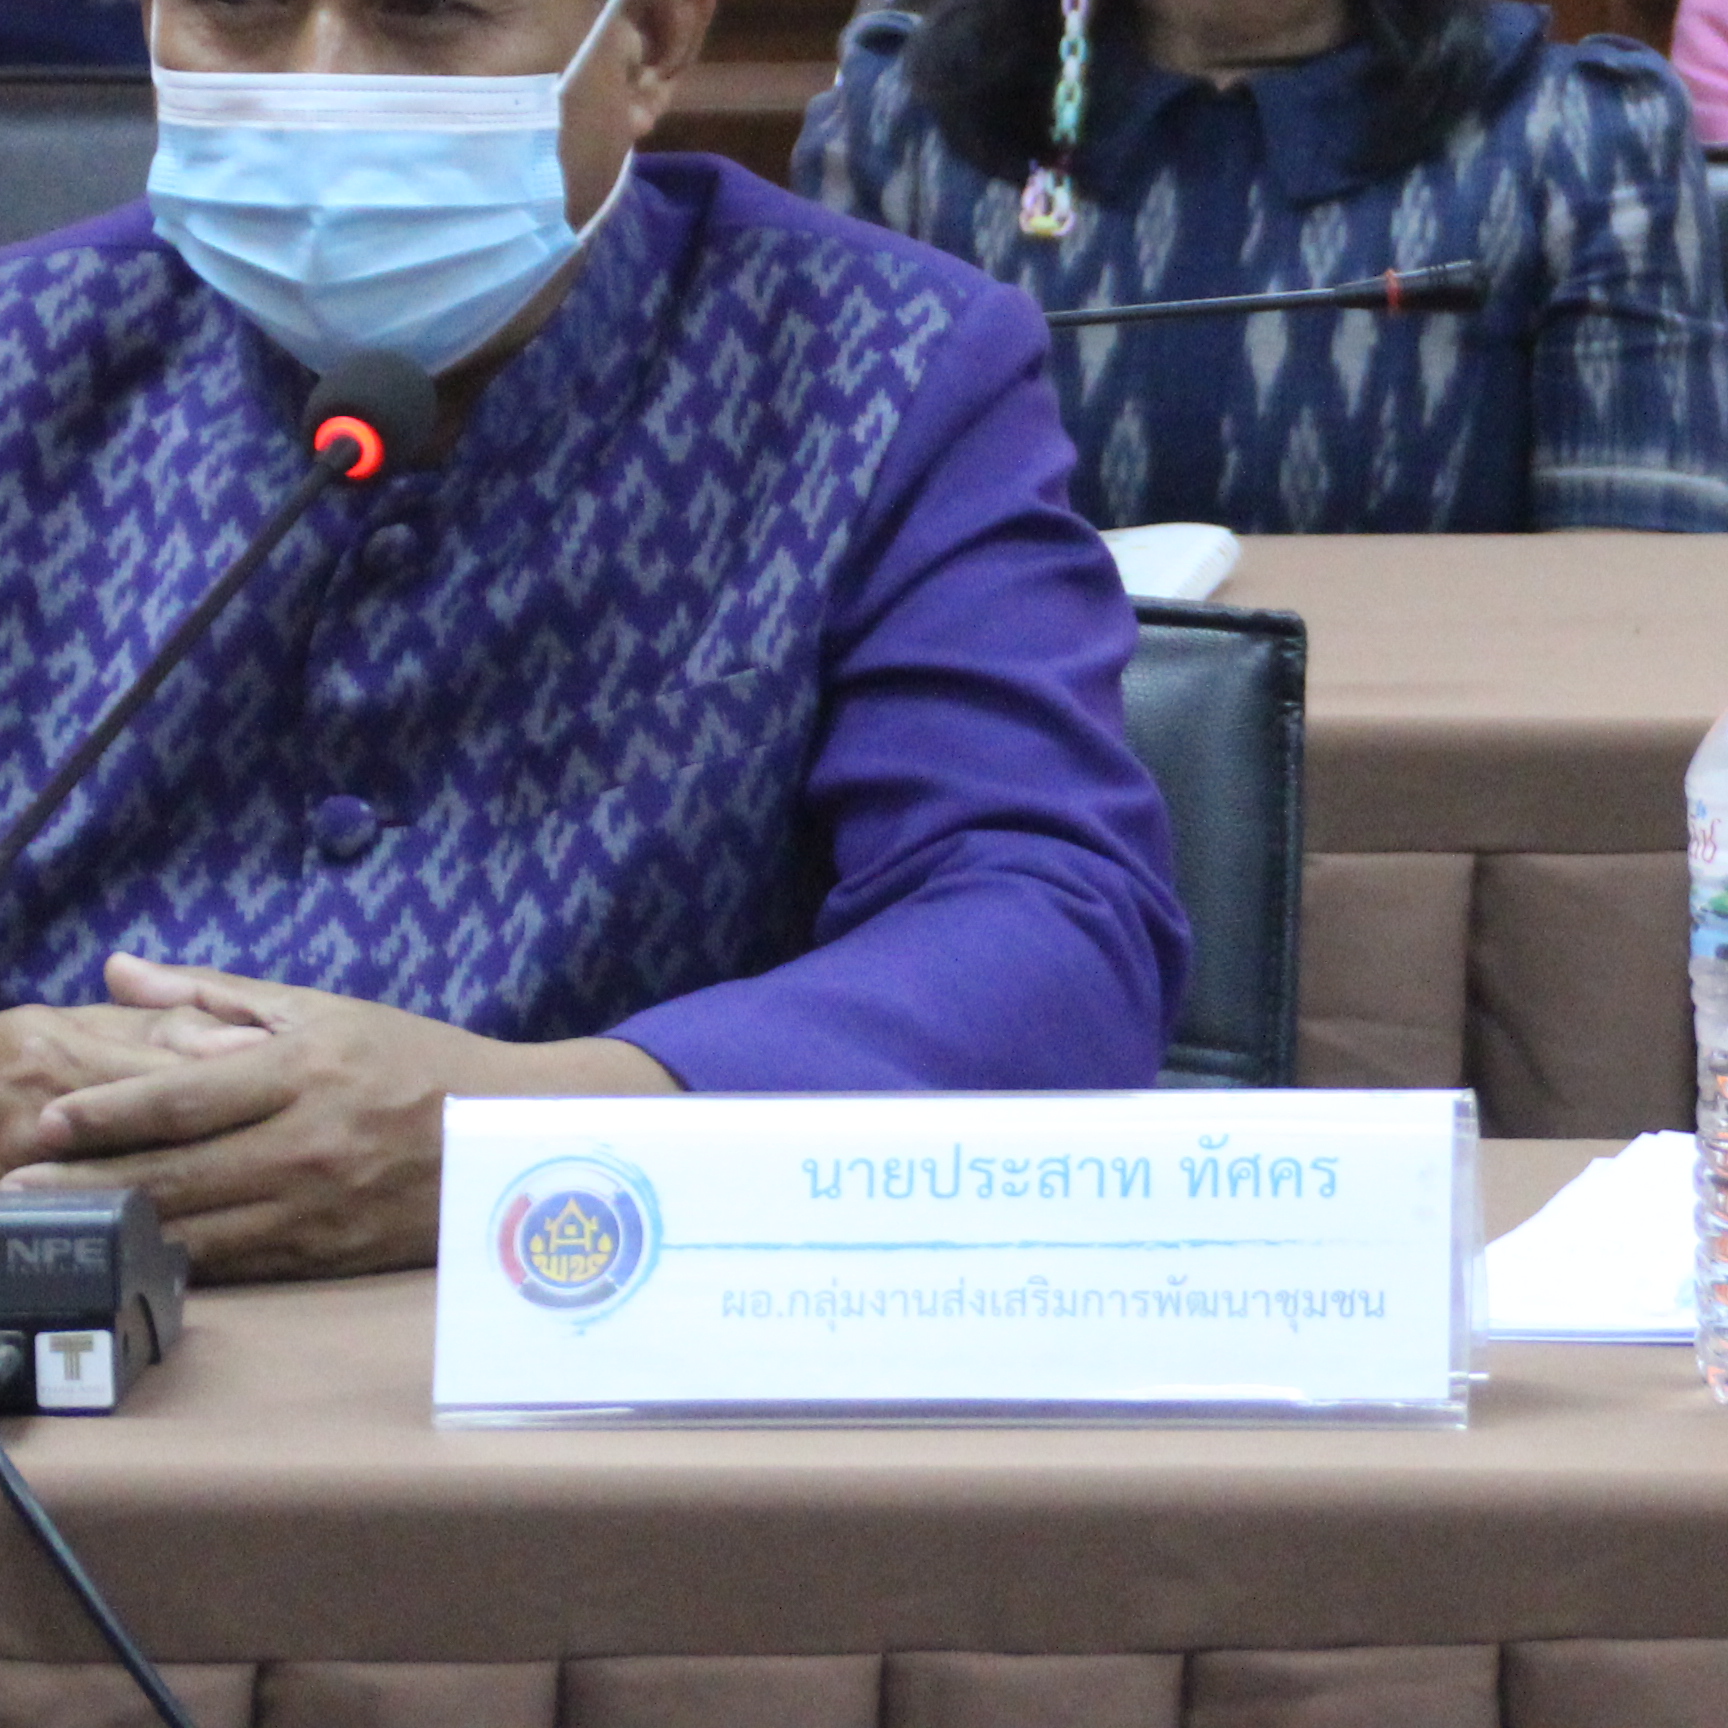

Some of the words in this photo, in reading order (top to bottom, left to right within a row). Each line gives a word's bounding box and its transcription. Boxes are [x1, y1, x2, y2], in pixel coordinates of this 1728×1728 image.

[801, 1142, 1152, 1200] นายประสาท
[1178, 1133, 1340, 1200] ทัศคร
[5, 1237, 109, 1264] NPE
[721, 1273, 1386, 1334] ผอ.กลุ่มงานส่งเสริมการพัฒนาชุมชน
